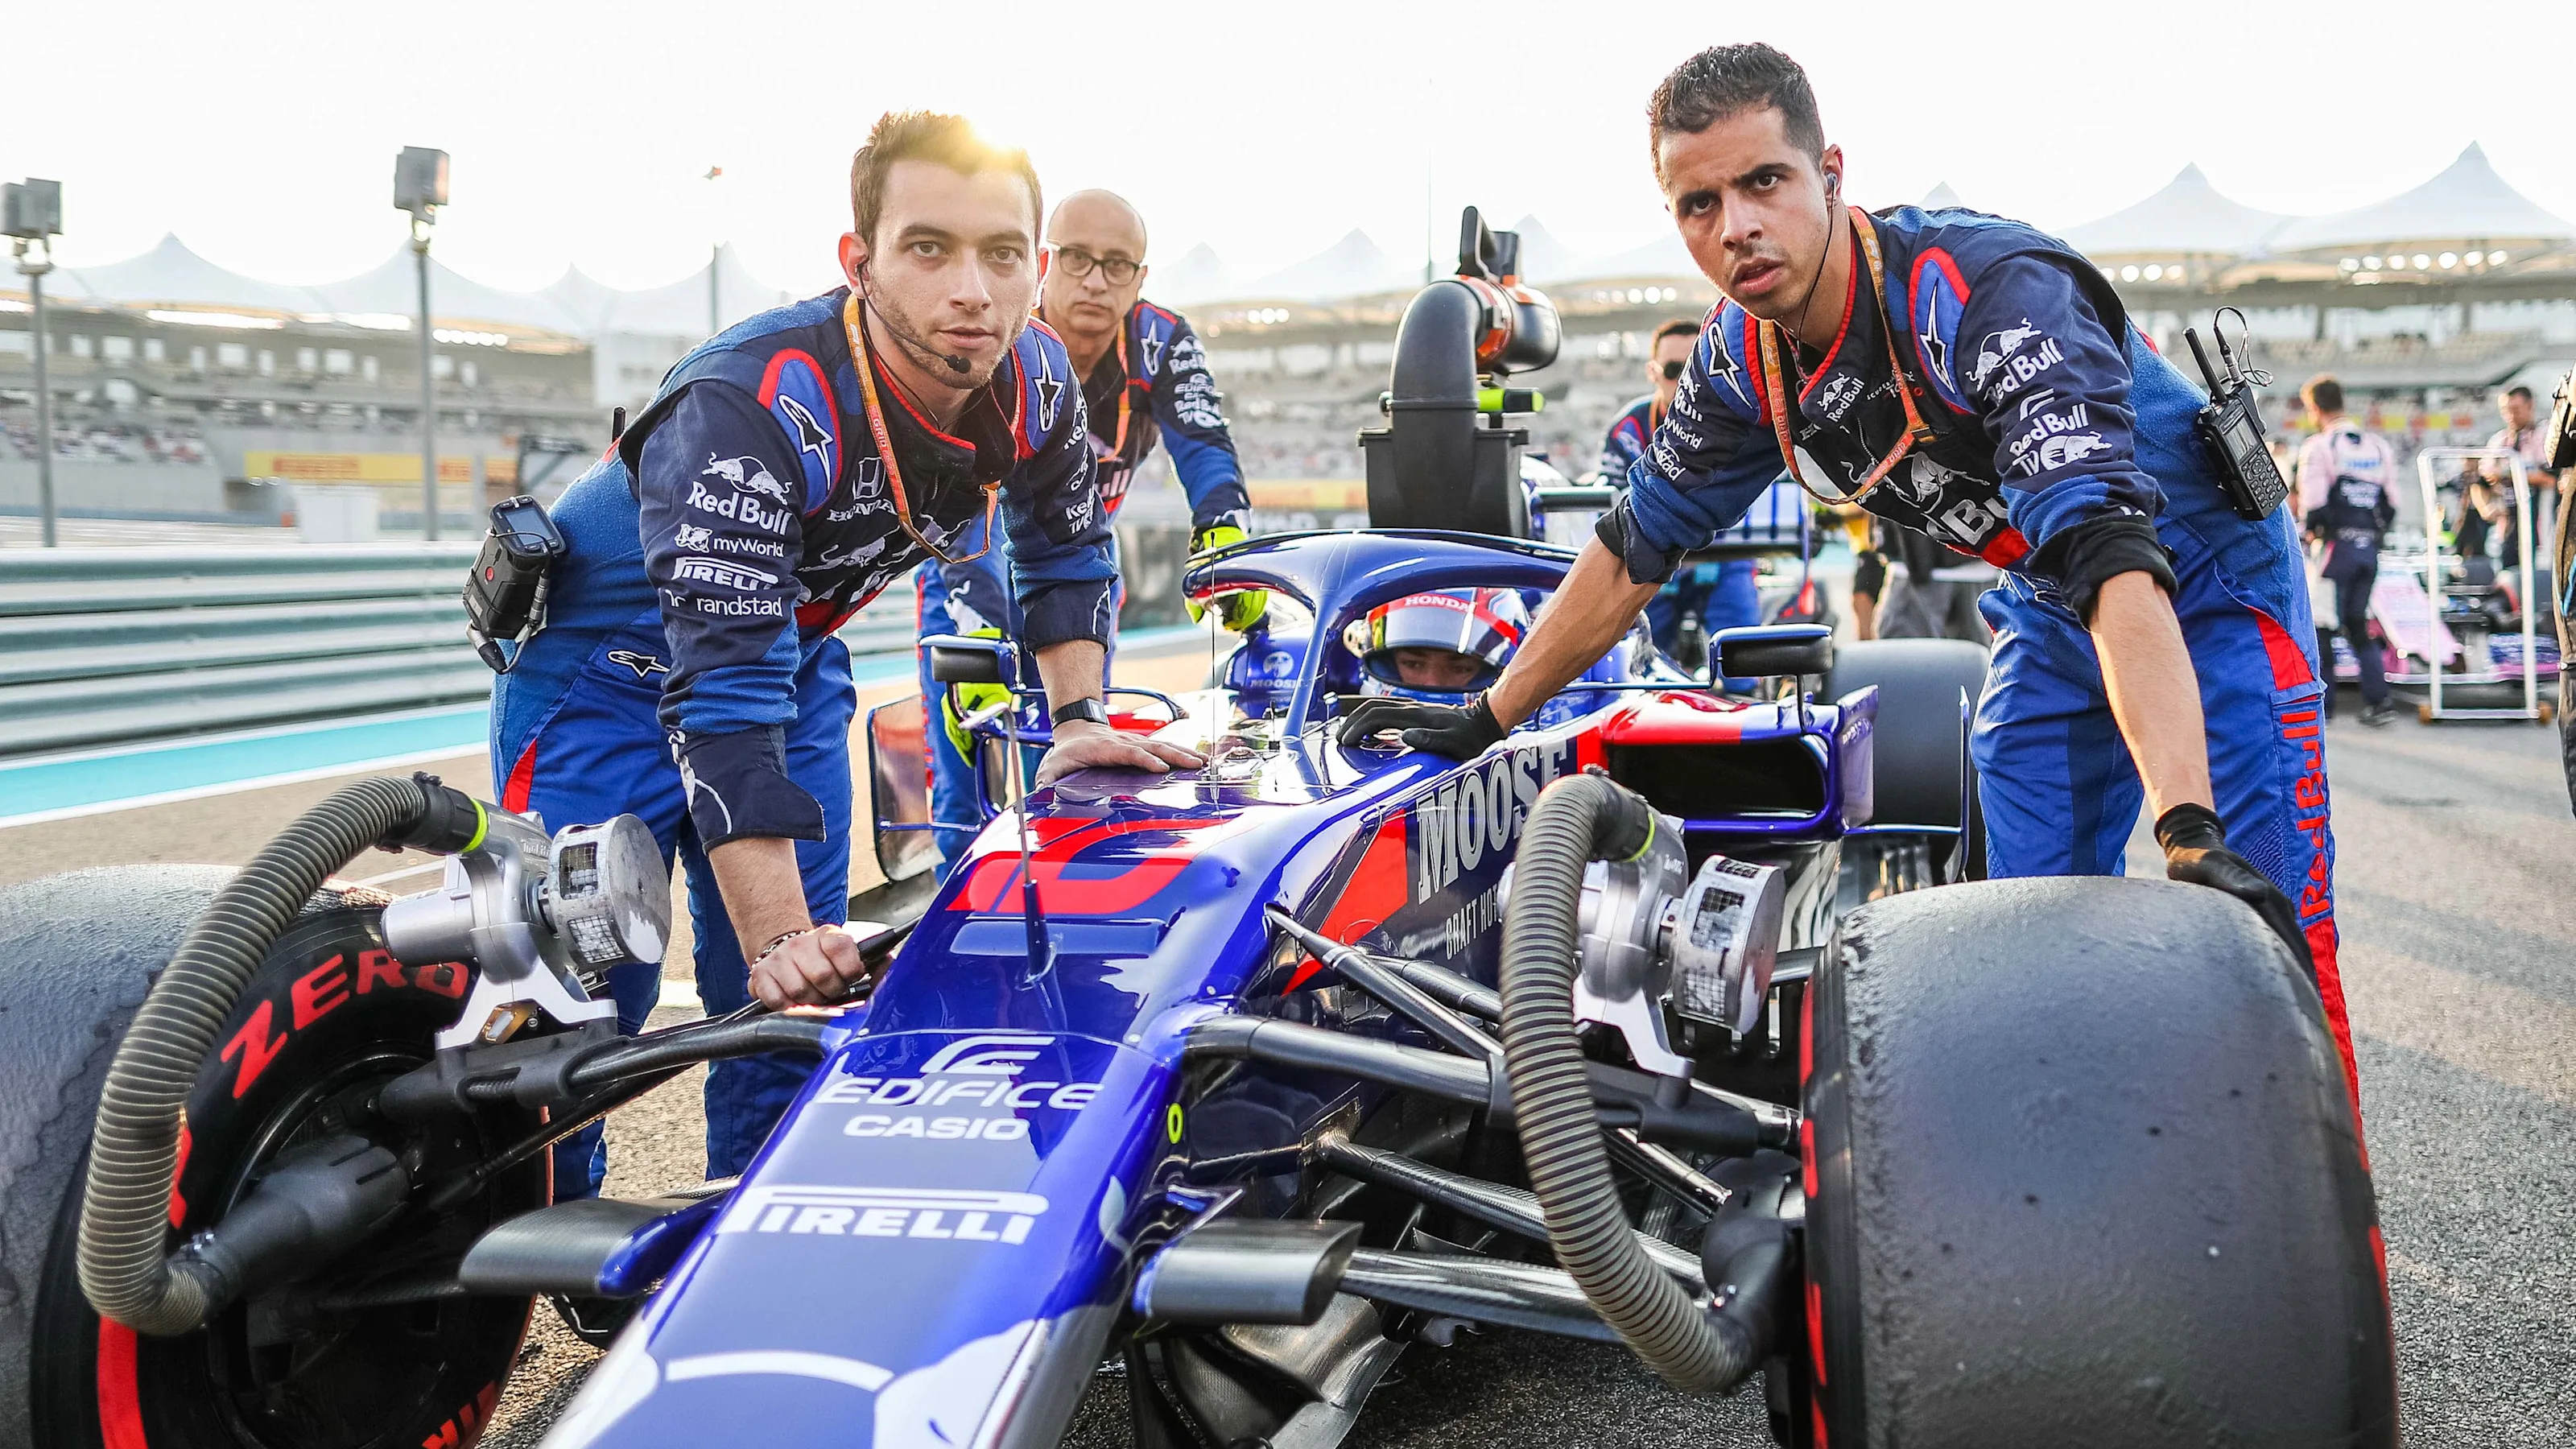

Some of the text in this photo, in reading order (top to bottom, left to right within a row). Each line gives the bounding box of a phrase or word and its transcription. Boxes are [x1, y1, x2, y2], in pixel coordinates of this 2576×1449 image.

[1169, 353, 1199, 375] Red
[2012, 336, 2065, 382] Bull
[1827, 377, 1865, 423] Red Bull
[873, 419, 887, 448] GRID
[2009, 402, 2089, 456] Red Bull
[2013, 450, 2041, 477] TV
[685, 481, 793, 536] Red Bull
[827, 498, 898, 523] HONDA
[713, 537, 784, 558] myWorld
[671, 556, 779, 591] PIRELL
[696, 595, 783, 617] randstad
[1404, 594, 1472, 612] HONDA
[1250, 678, 1297, 688] MOOS
[2281, 710, 2330, 919] Red Bull
[1446, 897, 1478, 960] CRAFT
[221, 948, 469, 1099] ZERO
[813, 1077, 1105, 1111] EDIFICE
[843, 1115, 1031, 1141] CASIO
[717, 1185, 1050, 1245] PIRELLI
